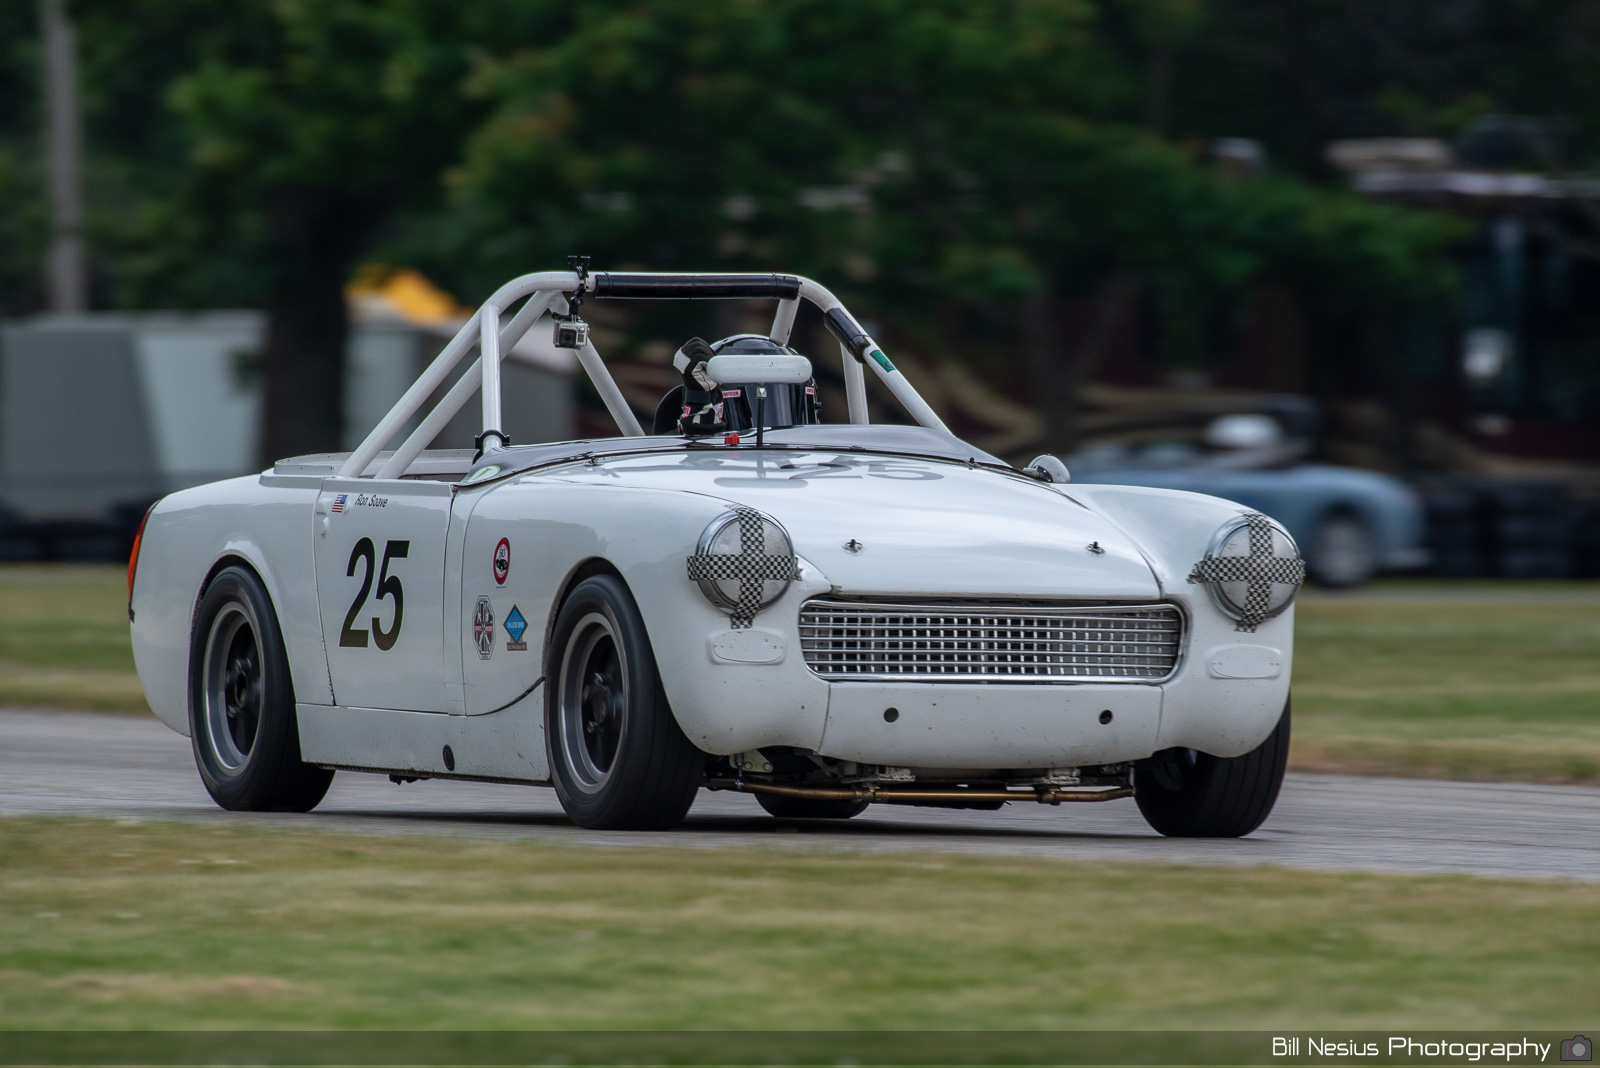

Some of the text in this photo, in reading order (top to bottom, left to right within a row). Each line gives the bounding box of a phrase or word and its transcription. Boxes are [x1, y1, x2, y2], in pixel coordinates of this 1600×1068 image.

[789, 463, 944, 480] 25
[354, 493, 389, 508] Ron Soave
[339, 537, 410, 651] 25
